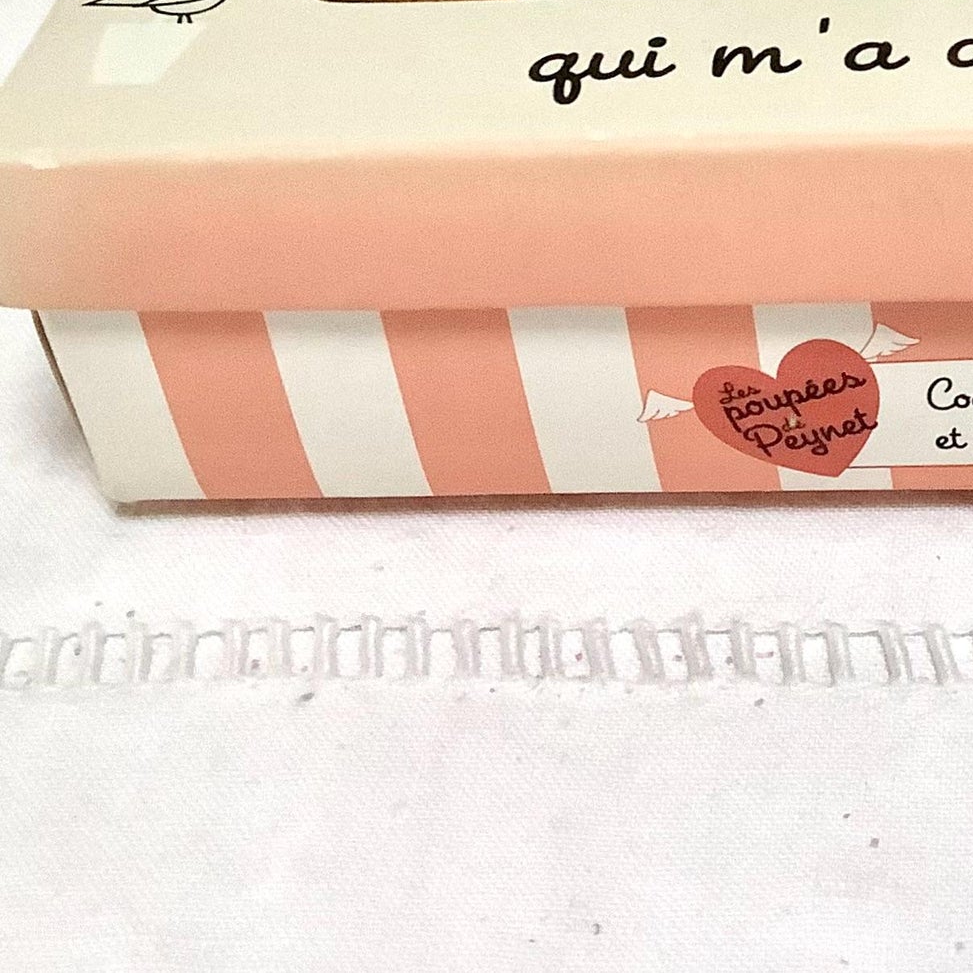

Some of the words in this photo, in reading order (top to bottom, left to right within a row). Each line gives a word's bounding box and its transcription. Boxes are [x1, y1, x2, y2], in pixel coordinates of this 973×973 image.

[528, 36, 677, 105] qui
[718, 381, 762, 405] Les
[723, 371, 867, 434] poupées
[742, 407, 879, 458] Peynet
[935, 427, 969, 450] et
